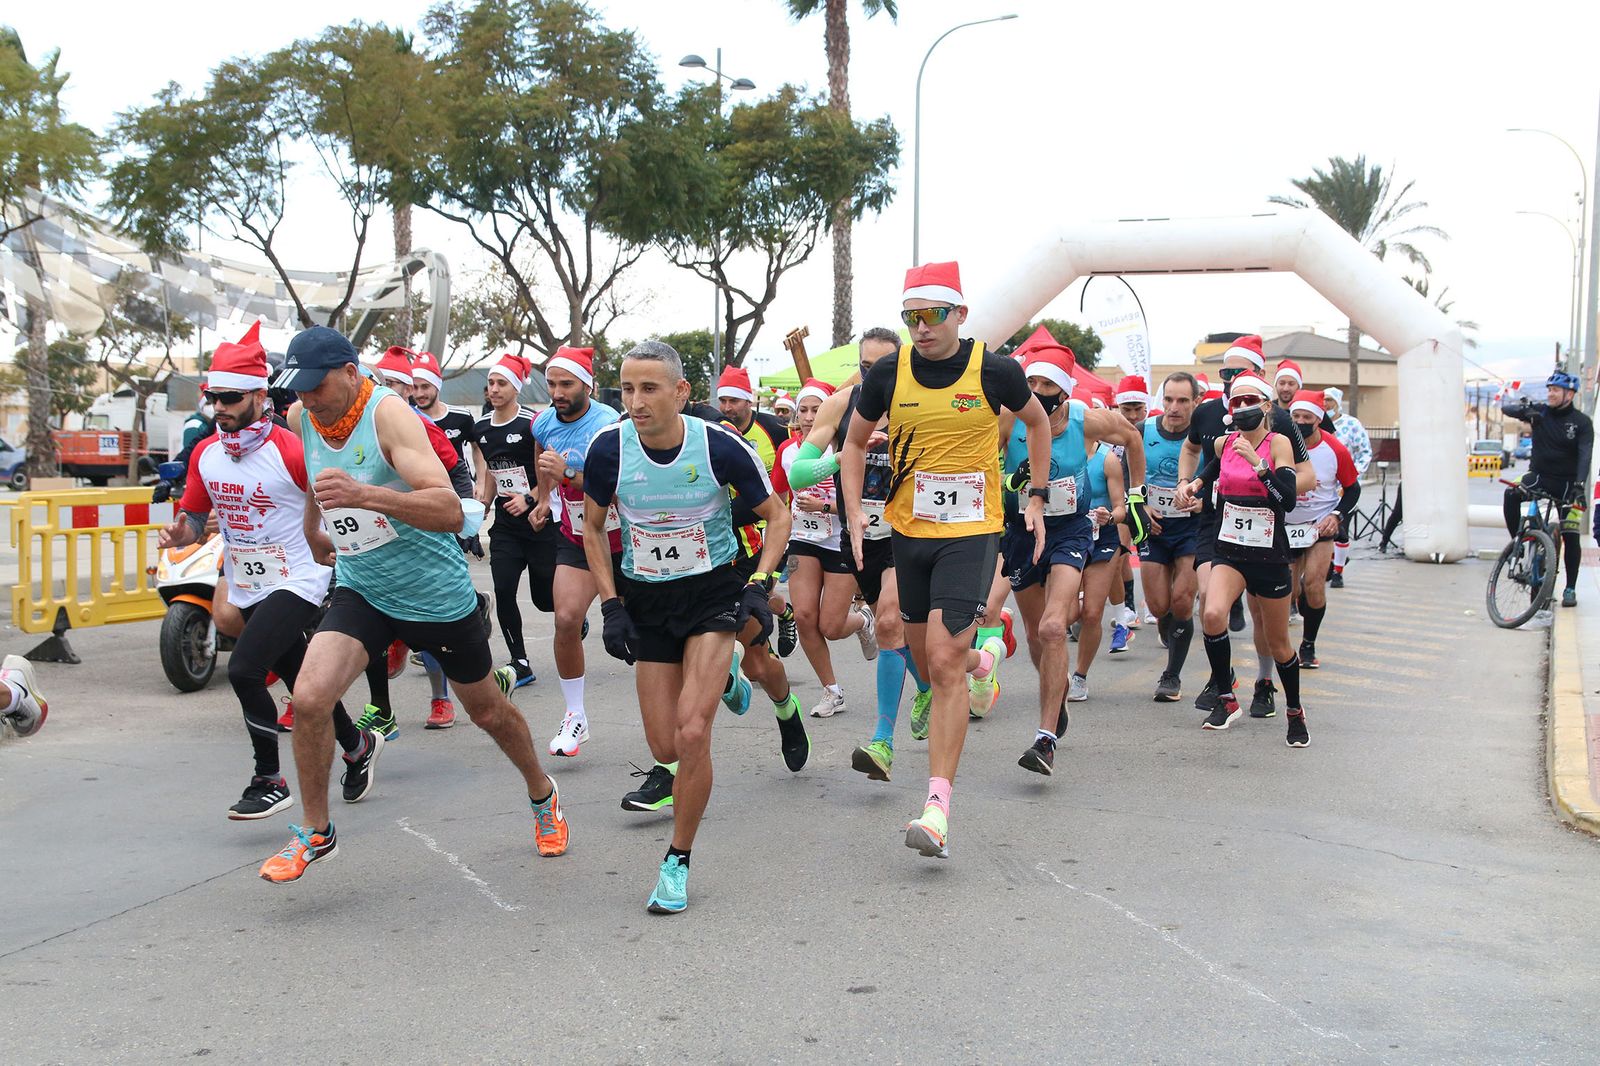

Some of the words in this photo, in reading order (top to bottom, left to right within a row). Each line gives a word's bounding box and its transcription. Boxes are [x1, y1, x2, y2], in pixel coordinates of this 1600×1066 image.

[209, 481, 219, 492] XII
[222, 483, 244, 495] SAN
[500, 479, 513, 488] 28
[933, 490, 958, 506] 31
[1158, 496, 1174, 506] 57
[333, 516, 359, 536] 59
[802, 519, 818, 530] 35
[1234, 518, 1253, 531] 51
[1290, 528, 1305, 538] 20
[650, 545, 680, 561] 14
[243, 561, 266, 576] 33
